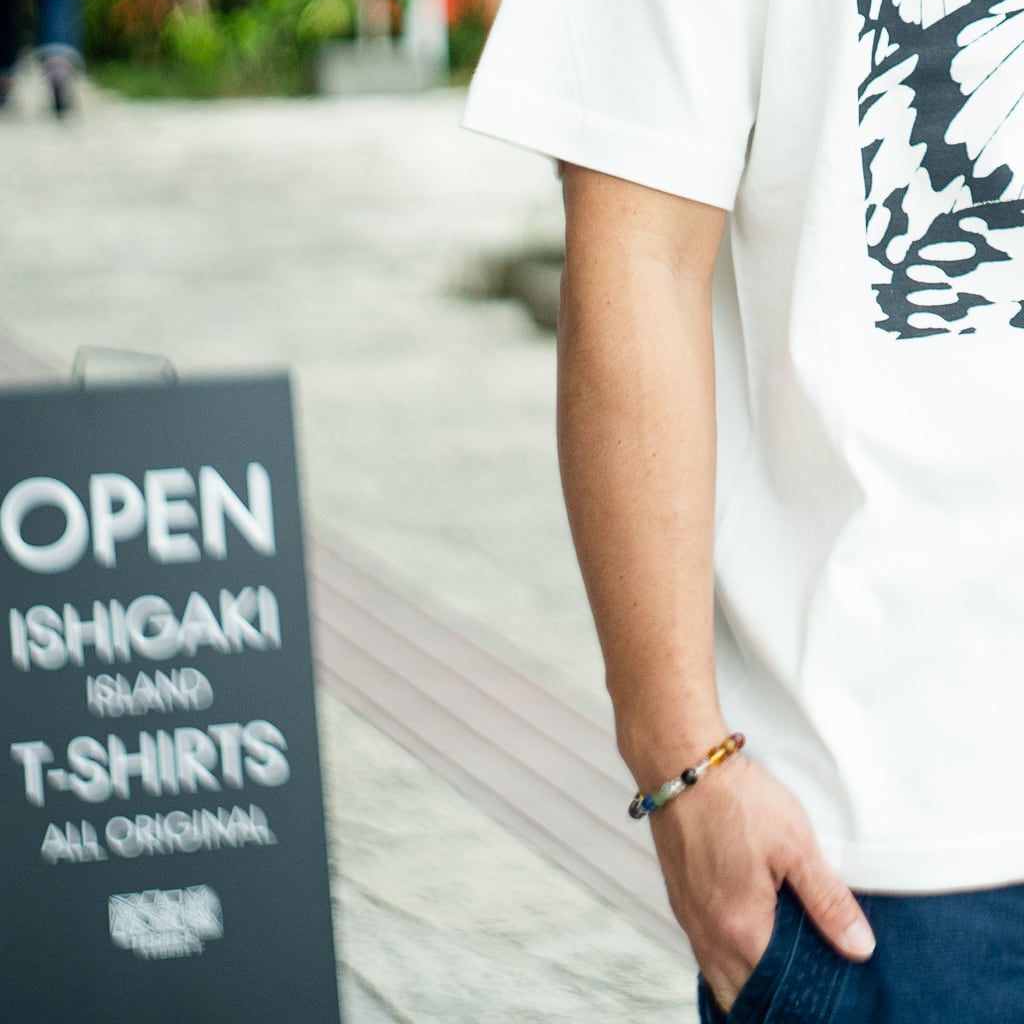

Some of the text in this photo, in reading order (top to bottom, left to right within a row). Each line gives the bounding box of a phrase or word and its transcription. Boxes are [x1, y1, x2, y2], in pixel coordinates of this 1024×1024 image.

[0, 462, 277, 574] OPEN
[10, 585, 282, 672] ISHIGAKI
[87, 667, 213, 718] ISLAND
[11, 720, 291, 808] T-SHIRTS
[41, 804, 278, 865] ALL ORIGINAL
